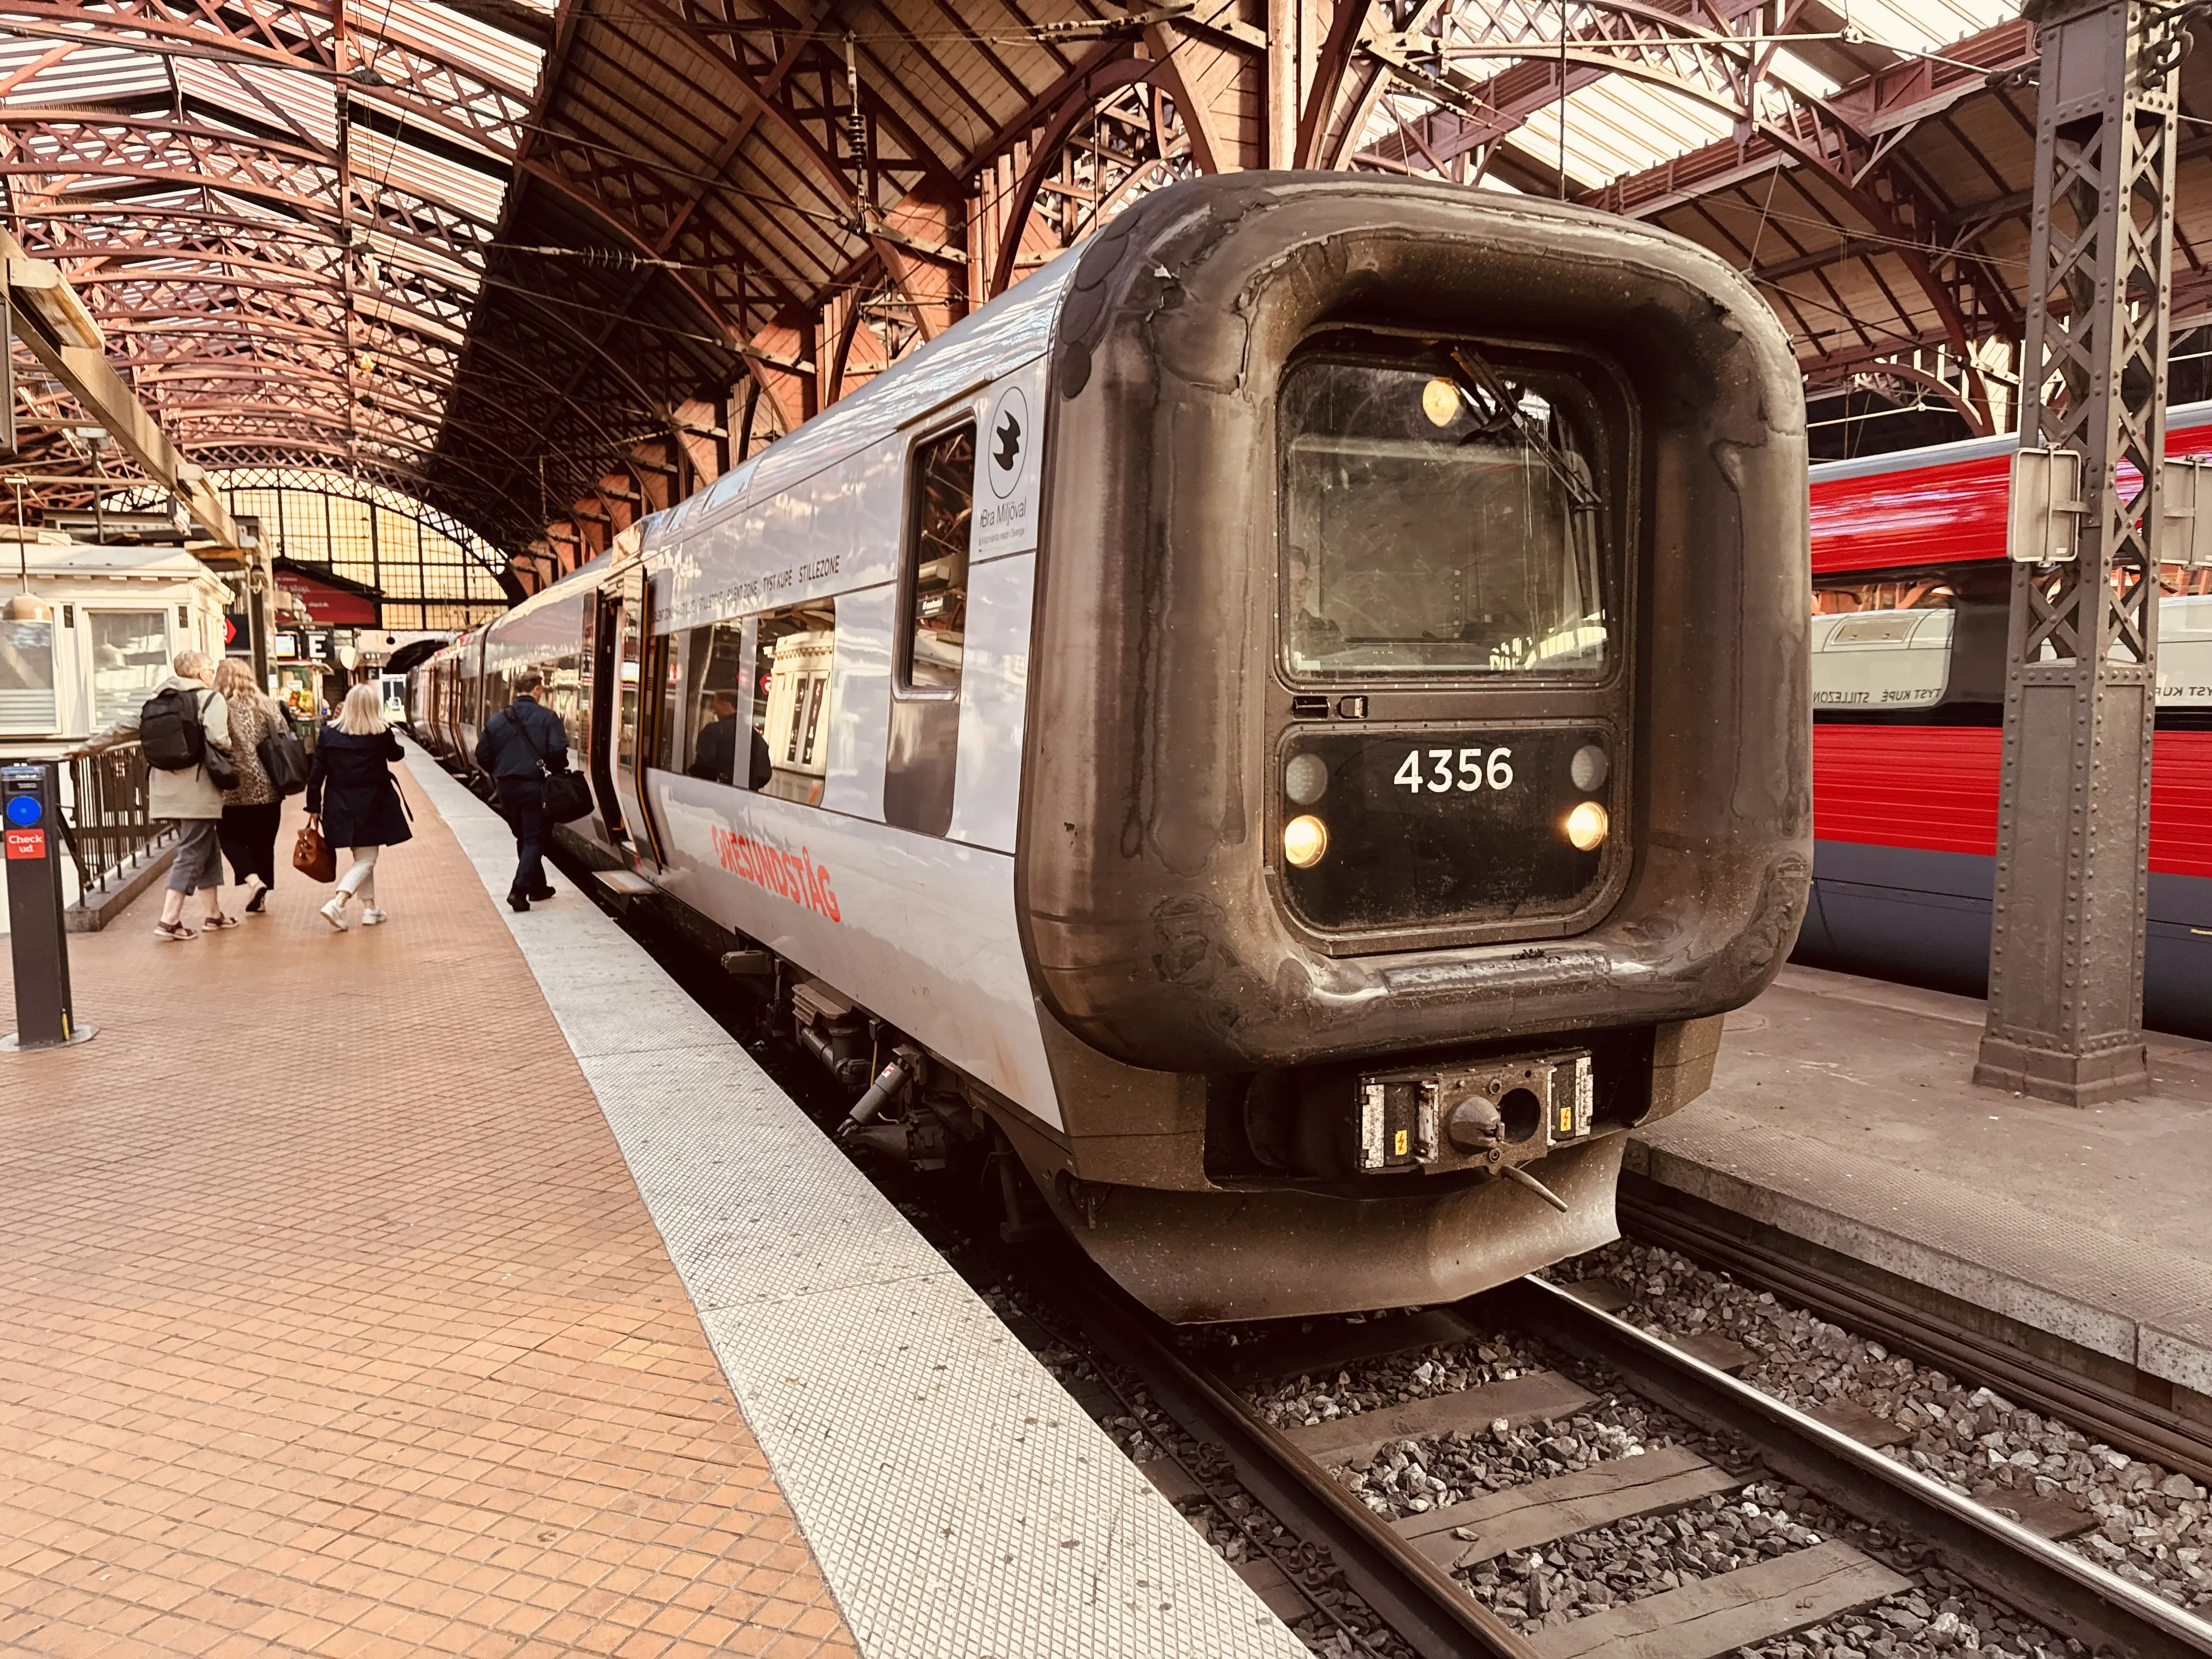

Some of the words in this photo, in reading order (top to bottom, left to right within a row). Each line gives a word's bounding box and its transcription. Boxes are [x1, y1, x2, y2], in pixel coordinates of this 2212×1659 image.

[980, 509, 995, 528] Bra
[996, 497, 1026, 526] Miljöval
[743, 580, 758, 599] ZONE
[763, 574, 776, 592] TYST
[777, 565, 792, 588] KUPÉ
[799, 555, 840, 583] STILLEZONE
[309, 635, 326, 658] E
[1393, 747, 1514, 793] 4356
[8, 834, 43, 844] Check
[18, 844, 35, 853] ud
